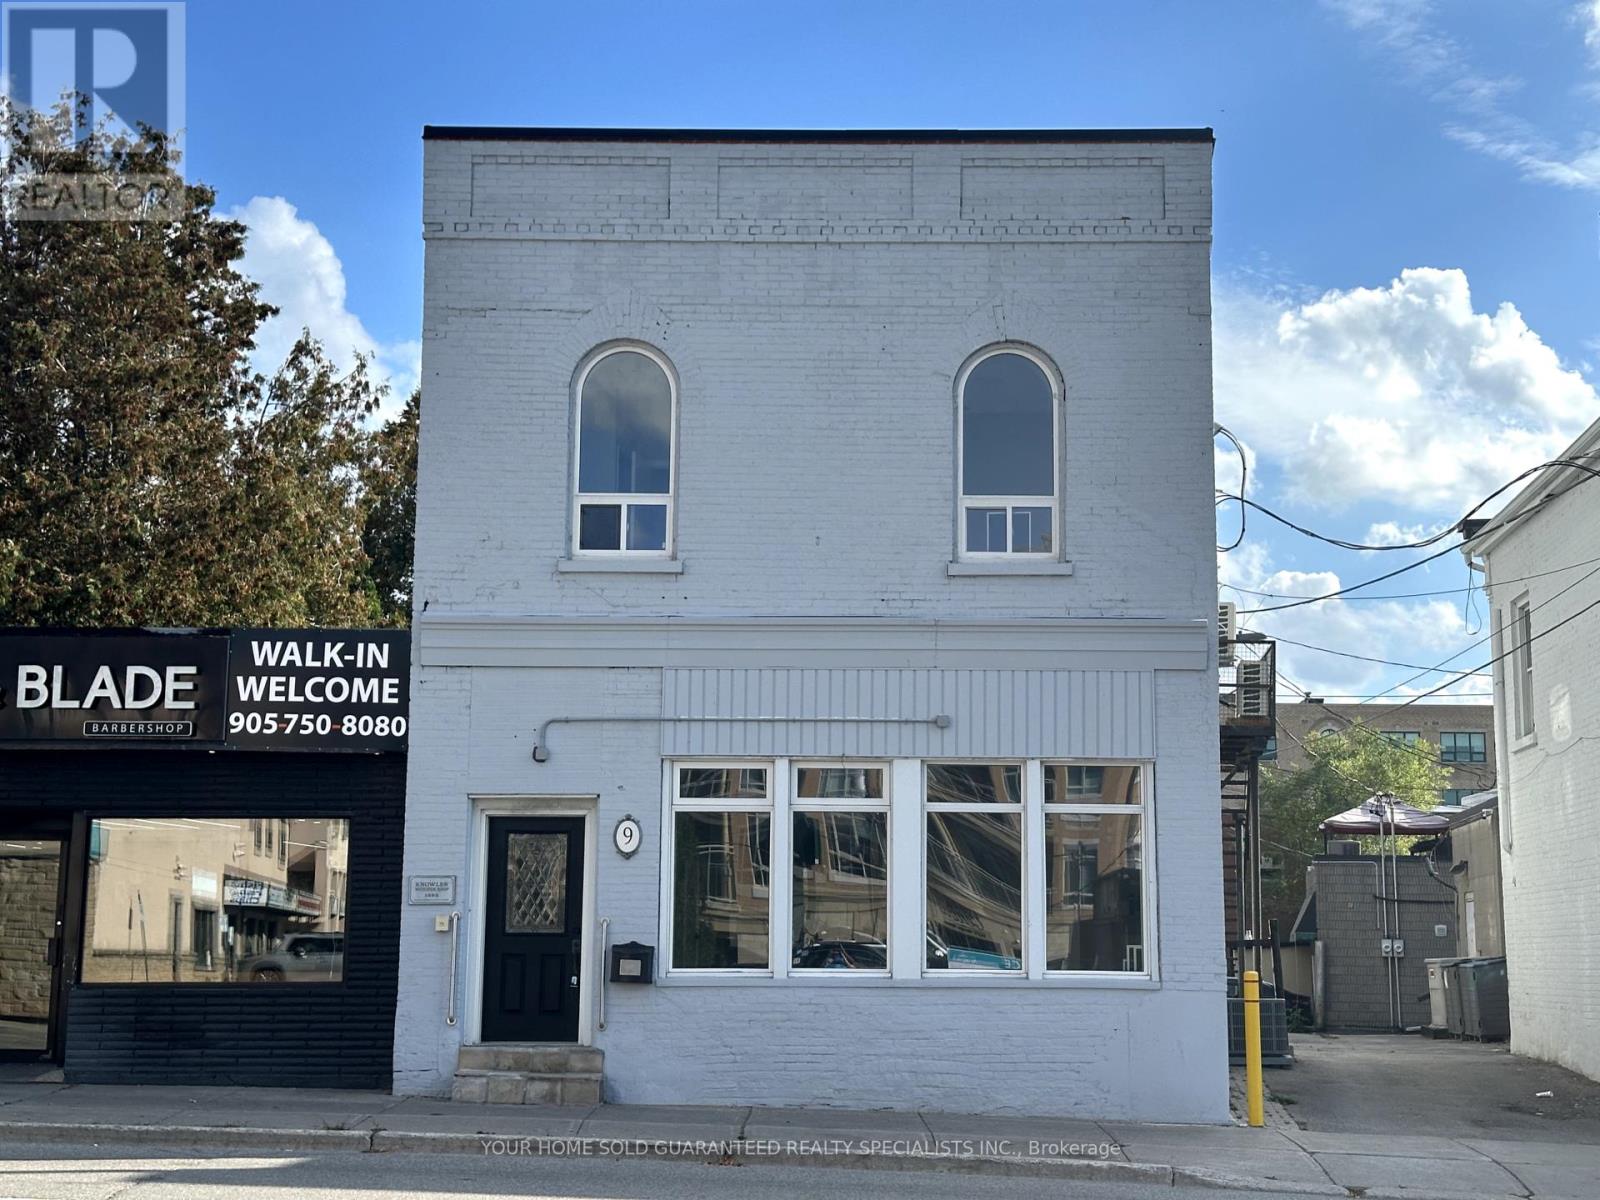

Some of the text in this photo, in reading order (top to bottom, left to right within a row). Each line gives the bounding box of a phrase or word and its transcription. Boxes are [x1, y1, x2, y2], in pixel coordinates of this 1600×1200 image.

[251, 640, 390, 668] WALK-IN
[16, 664, 198, 710] BLADE
[236, 675, 400, 704] WELCOME
[92, 722, 185, 734] BARBERSHOP
[229, 712, 408, 738] 905-750-8080
[623, 826, 634, 845] 9
